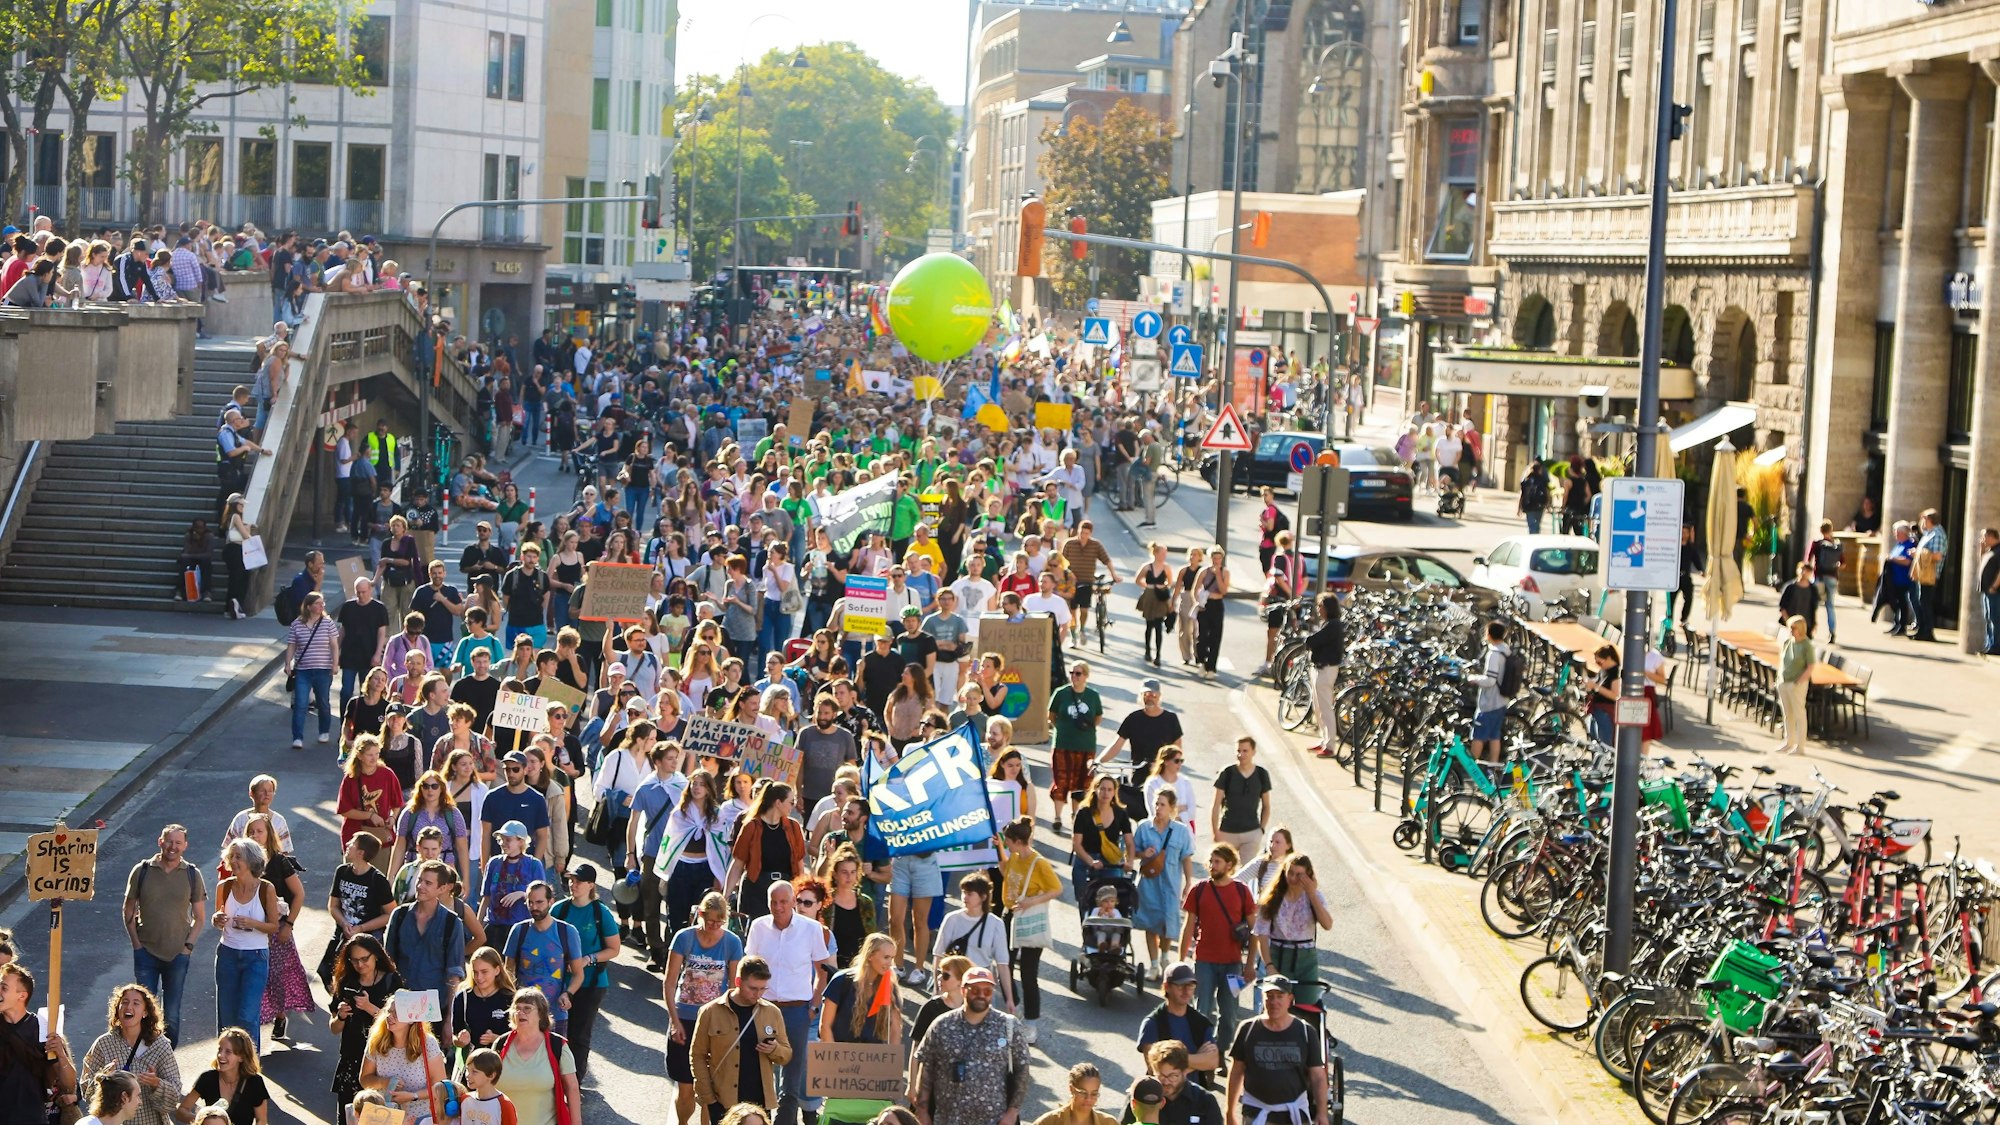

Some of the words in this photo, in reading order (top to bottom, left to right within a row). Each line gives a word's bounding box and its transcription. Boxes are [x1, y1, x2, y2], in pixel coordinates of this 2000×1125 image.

[1509, 371, 1562, 387] Excelsior
[848, 603, 883, 613] Sofort!
[847, 617, 883, 626] Autofreier
[851, 624, 879, 633] Sonntag
[980, 627, 1006, 642] WIR
[1009, 627, 1046, 643] HABEN
[1012, 644, 1044, 660] EINE
[503, 692, 541, 709] PEOPLE
[500, 712, 539, 729] PROFIT
[691, 719, 709, 731] ICH
[745, 735, 763, 750] NO
[756, 751, 794, 773] WITHOUT
[869, 734, 981, 816] KFR
[876, 810, 934, 833] KÖLNER
[37, 837, 95, 856] Sharing
[814, 1049, 897, 1065] WIRTSCHAFT
[812, 1077, 900, 1093] KLIMASCHUTZ
